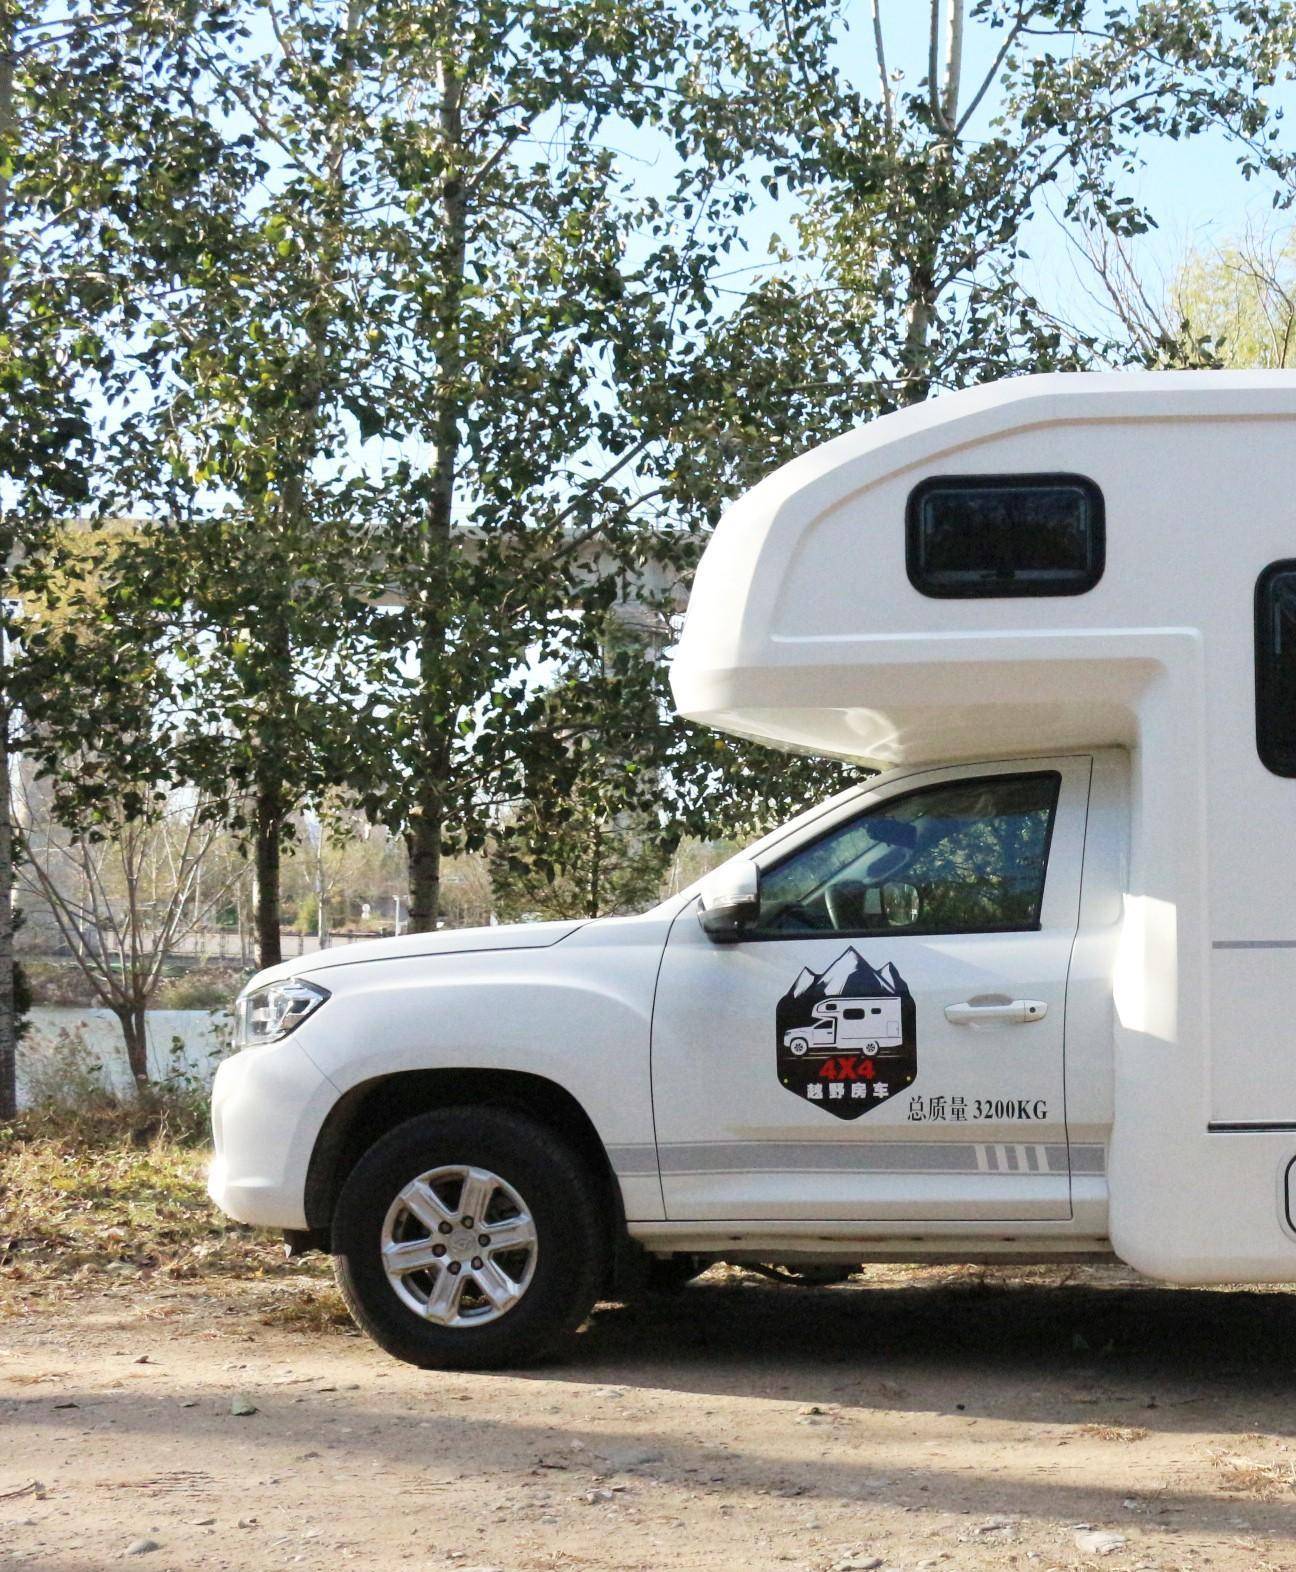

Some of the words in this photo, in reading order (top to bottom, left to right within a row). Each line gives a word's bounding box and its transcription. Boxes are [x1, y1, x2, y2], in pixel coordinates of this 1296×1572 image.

[907, 1095, 968, 1121] 总质量
[973, 1099, 1048, 1120] 3200KG
